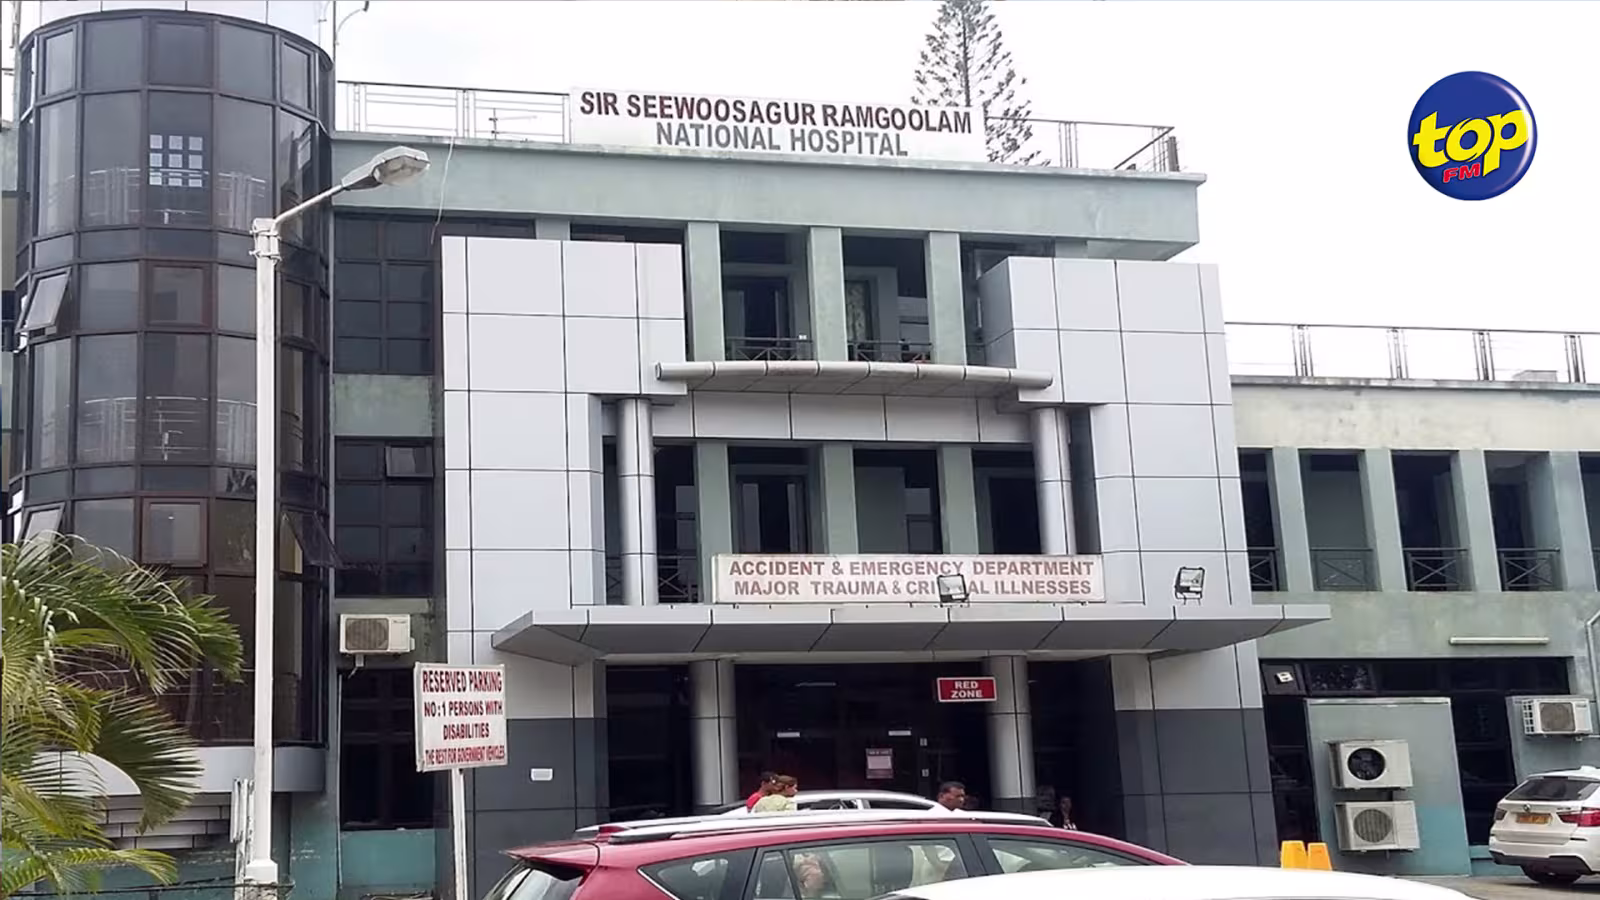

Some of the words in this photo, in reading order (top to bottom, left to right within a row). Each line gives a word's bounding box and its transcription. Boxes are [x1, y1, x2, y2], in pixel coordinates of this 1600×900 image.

[580, 91, 619, 116] SIR
[627, 94, 816, 126] SEEWOOSAGUR
[822, 104, 971, 134] RAMGOOLAM
[656, 121, 781, 151] NATIONAL
[790, 128, 908, 156] HOSPITAL
[729, 561, 825, 576] ACCIDENT
[831, 561, 844, 576] &
[850, 561, 964, 576] EMERGENCY
[973, 561, 1094, 576] DEPARTMENT
[734, 581, 800, 596] MAJOR
[810, 581, 888, 596] TRAUMA
[892, 580, 902, 596] &
[906, 580, 990, 596] CRIAL
[995, 580, 1091, 595] ILLNESSES
[422, 670, 466, 692] RESERVED
[469, 670, 502, 692] PARKING
[954, 680, 979, 689] RED
[950, 689, 983, 699] ZONE
[449, 700, 484, 716] PERSONS
[485, 700, 503, 716] WITH
[443, 722, 490, 740] DISABILITIES
[425, 749, 435, 765] THE
[448, 747, 456, 763] FOR
